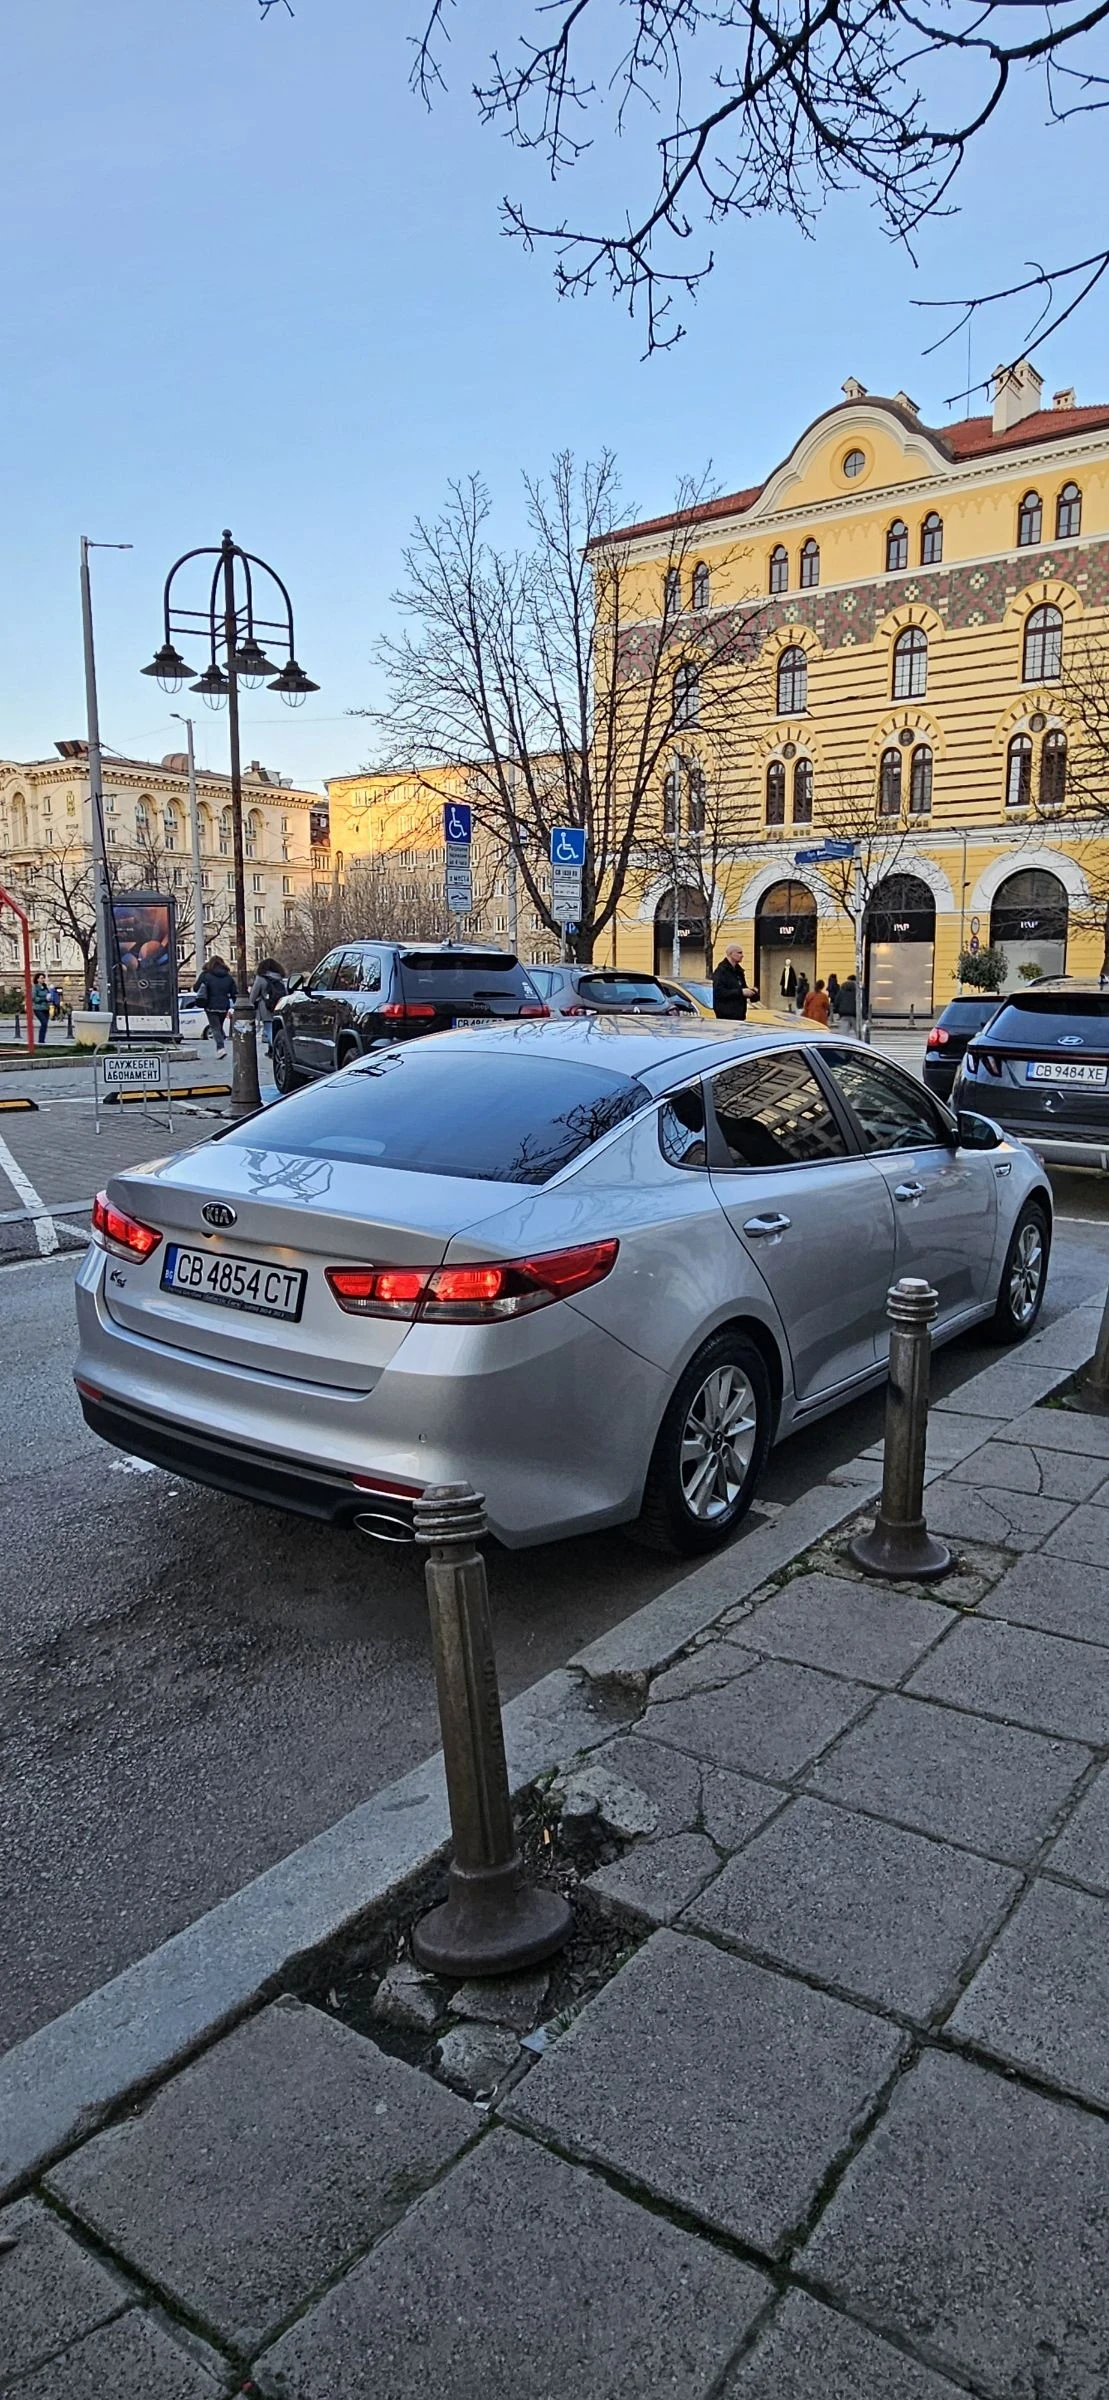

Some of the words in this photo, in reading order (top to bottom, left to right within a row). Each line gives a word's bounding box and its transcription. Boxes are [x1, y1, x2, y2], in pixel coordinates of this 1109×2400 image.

[471, 1003, 489, 1011] Jeep
[108, 1059, 155, 1070] СЛУЖЕБЕН
[107, 1070, 157, 1080] АБОНАМЕНТ
[1035, 1064, 1052, 1077] CB
[1055, 1065, 1084, 1079] 9484
[1087, 1067, 1104, 1081] XE
[205, 1205, 230, 1225] KIA
[165, 1269, 174, 1280] BG
[177, 1254, 204, 1286] CB
[207, 1260, 261, 1300] 4854
[264, 1272, 298, 1307] CT
